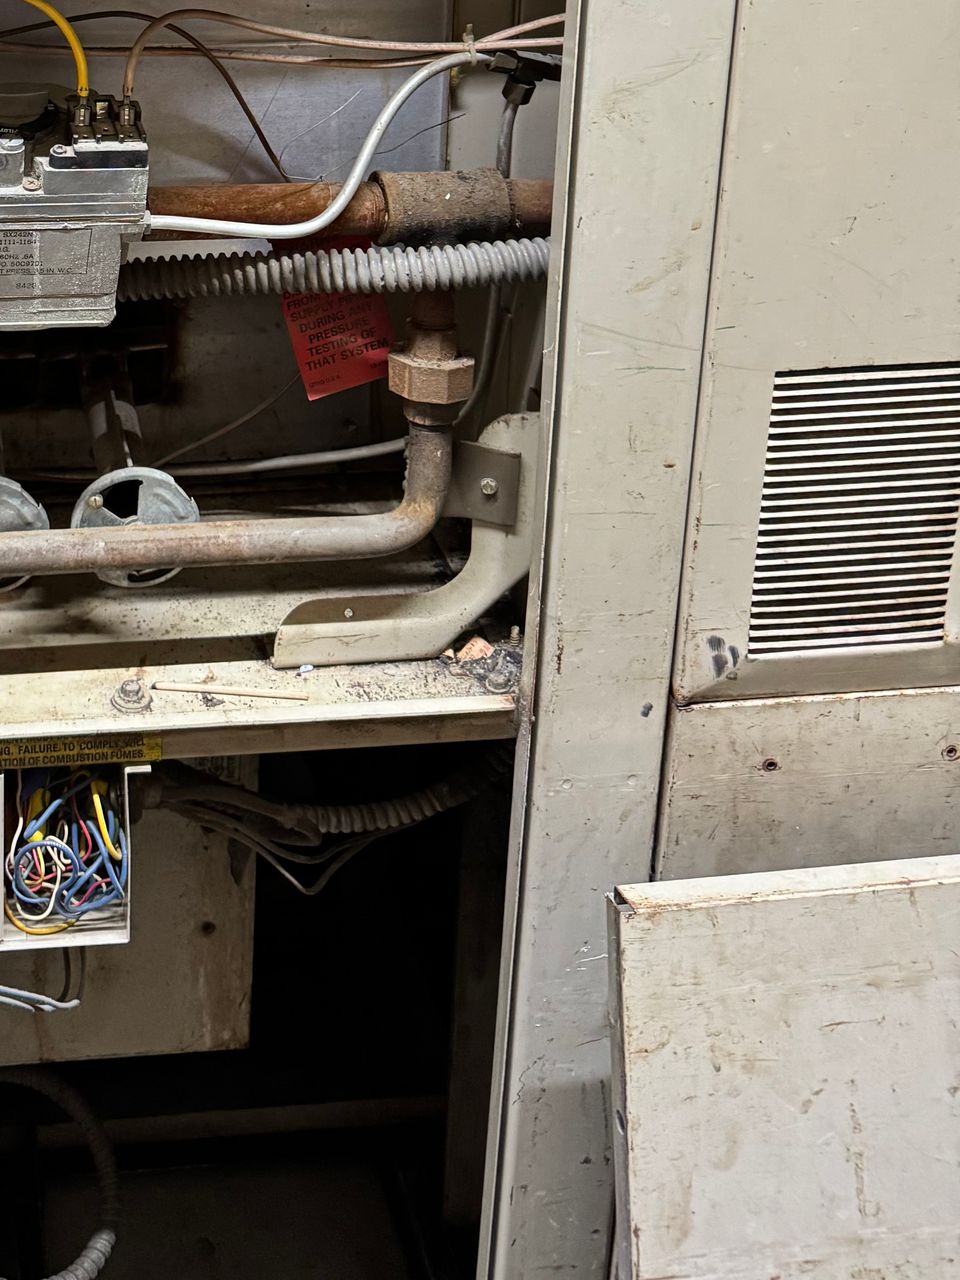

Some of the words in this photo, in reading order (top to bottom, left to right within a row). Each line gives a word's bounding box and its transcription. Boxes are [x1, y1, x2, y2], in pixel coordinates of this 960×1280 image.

[300, 311, 345, 333] DURING
[307, 317, 370, 344] PRESSURE
[307, 332, 358, 357] TESTING
[360, 326, 378, 339] OF
[305, 353, 337, 372] THAT
[340, 337, 390, 360] SYSTEM
[18, 742, 60, 755] FAILURE
[62, 742, 76, 752] TO
[79, 738, 121, 751] COMPLY
[28, 754, 41, 766] OF
[42, 751, 109, 765] COMBUSTION
[111, 748, 146, 760] FUMES.
